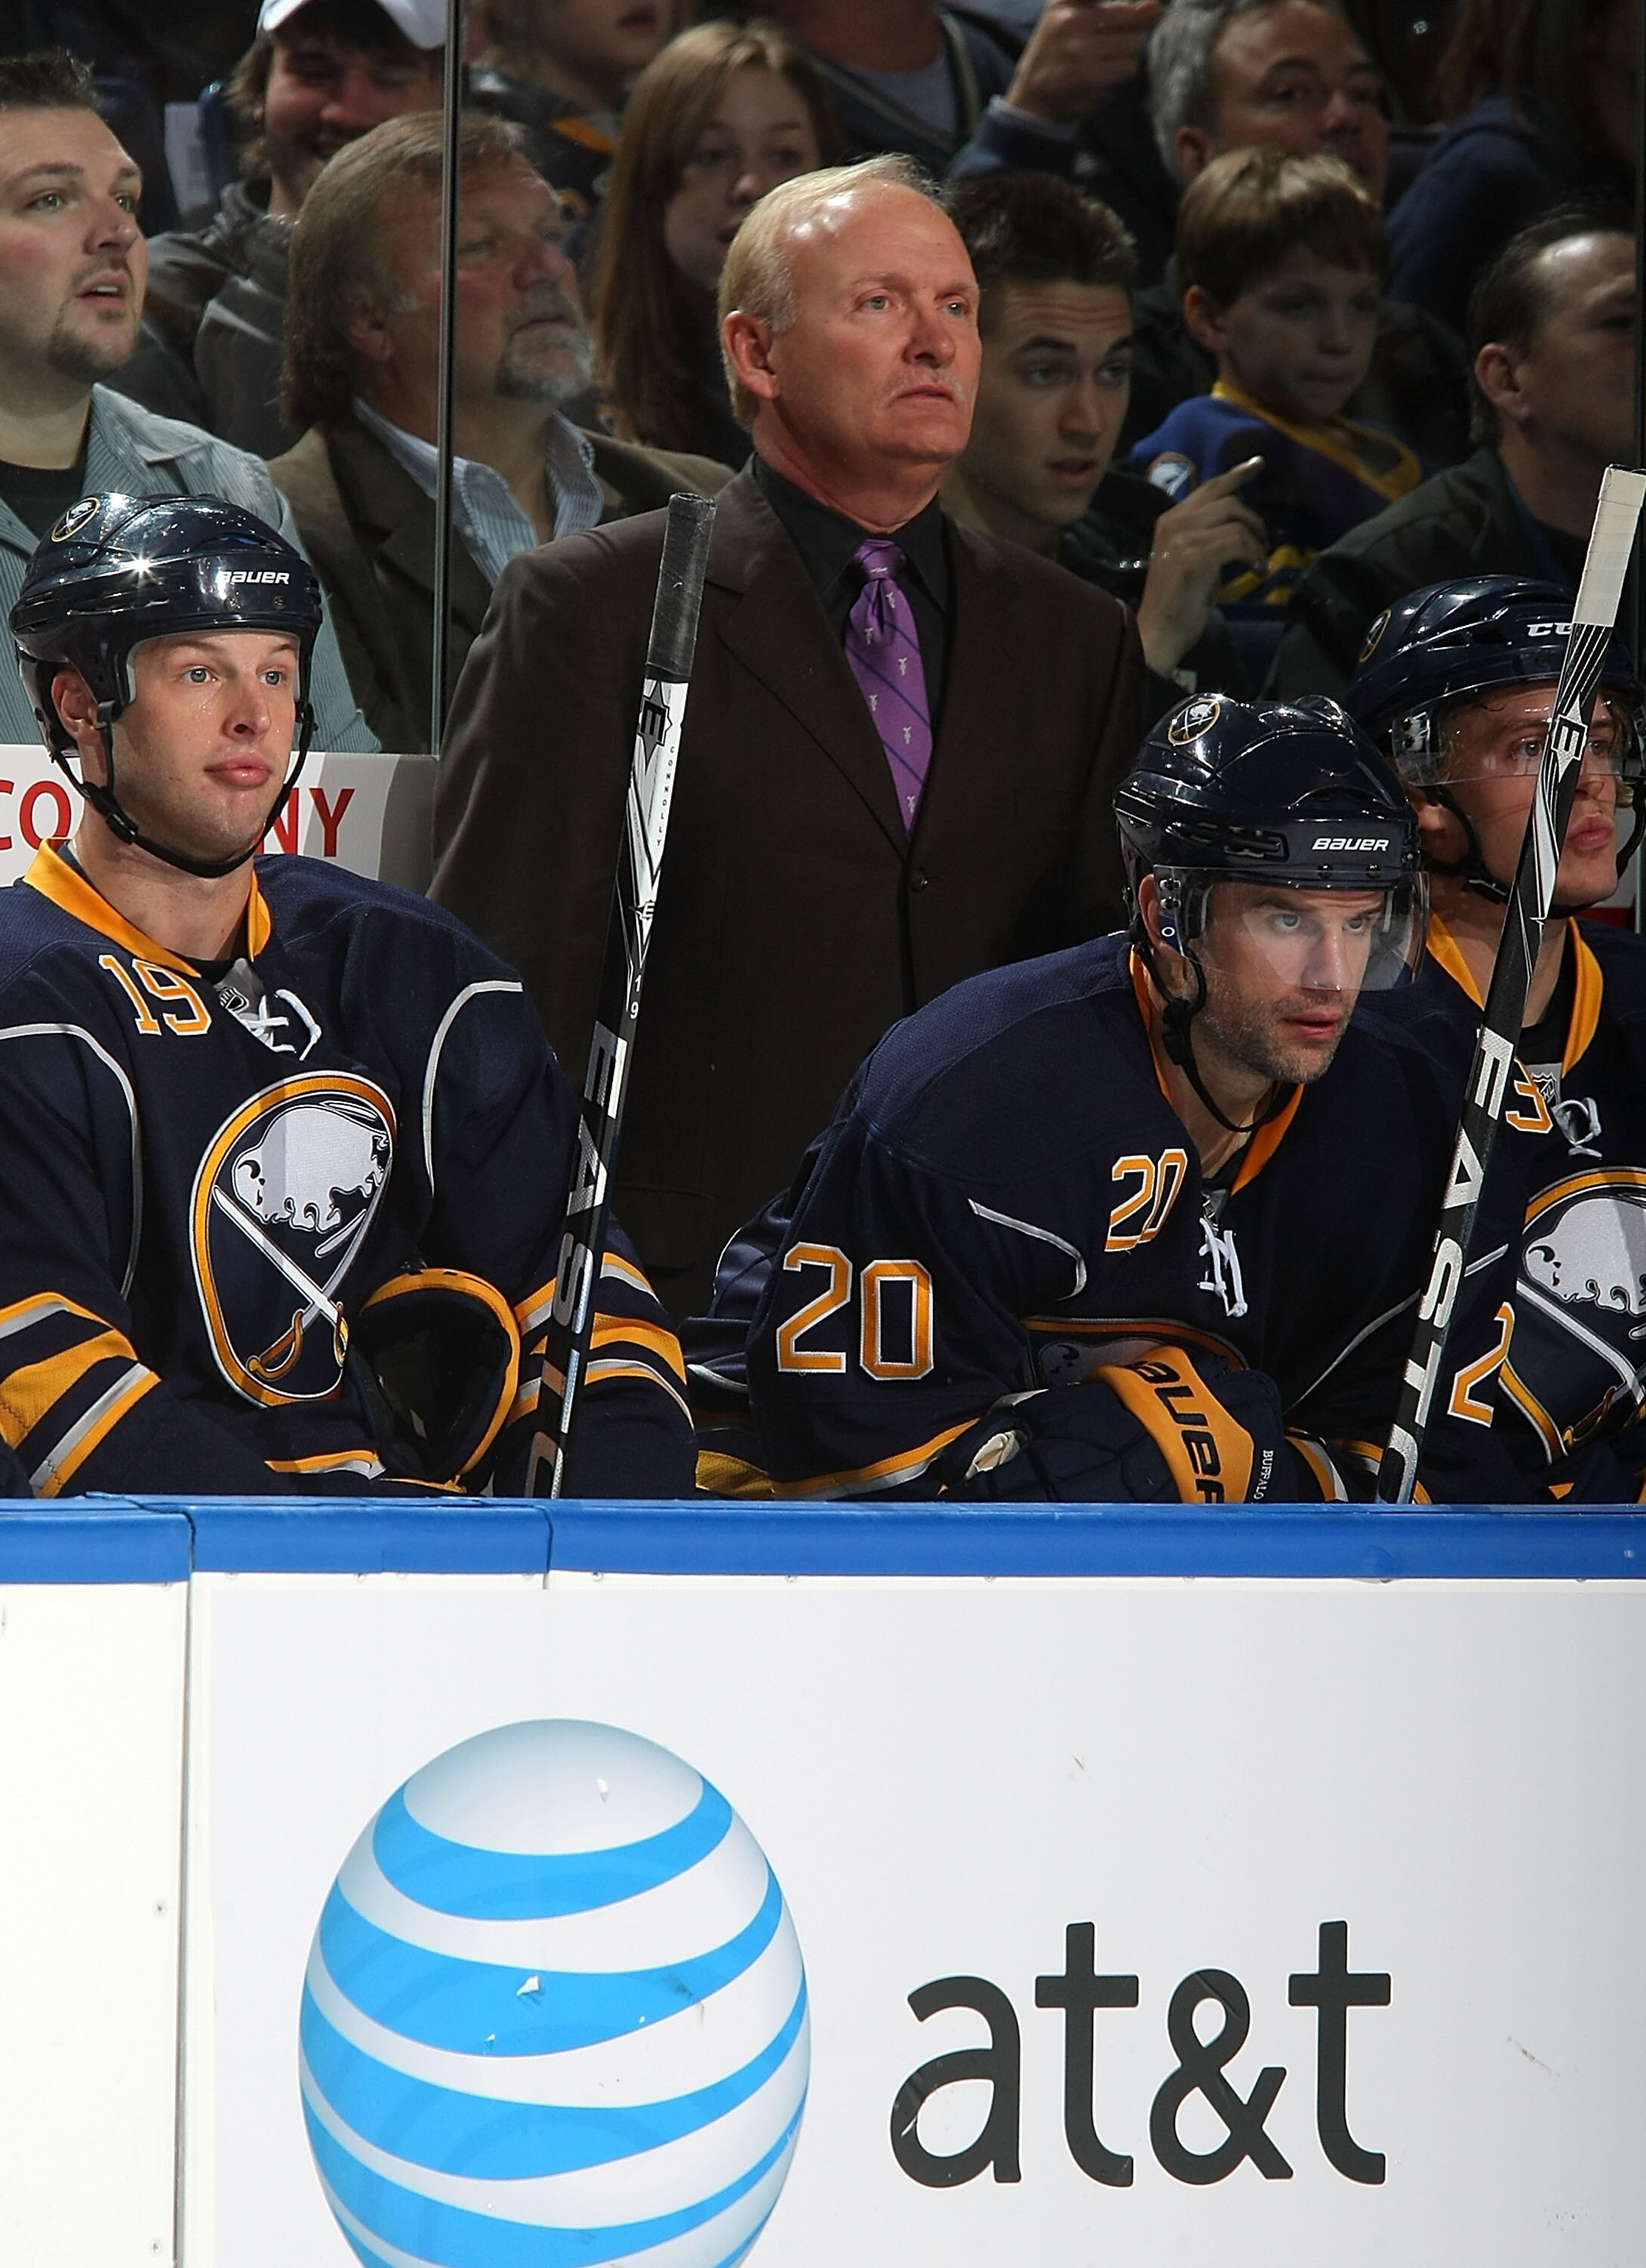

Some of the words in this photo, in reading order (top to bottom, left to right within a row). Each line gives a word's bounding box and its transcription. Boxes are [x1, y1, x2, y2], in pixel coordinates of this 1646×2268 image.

[656, 745, 675, 847] CONNOLLY
[1312, 838, 1390, 852] BAUER
[98, 954, 212, 1036] 19
[630, 974, 642, 1019] 19
[1104, 1148, 1188, 1253] 20
[776, 1241, 935, 1381] 20
[1253, 1449, 1274, 1500] BUFFALO
[890, 1919, 1391, 2188] at&t
